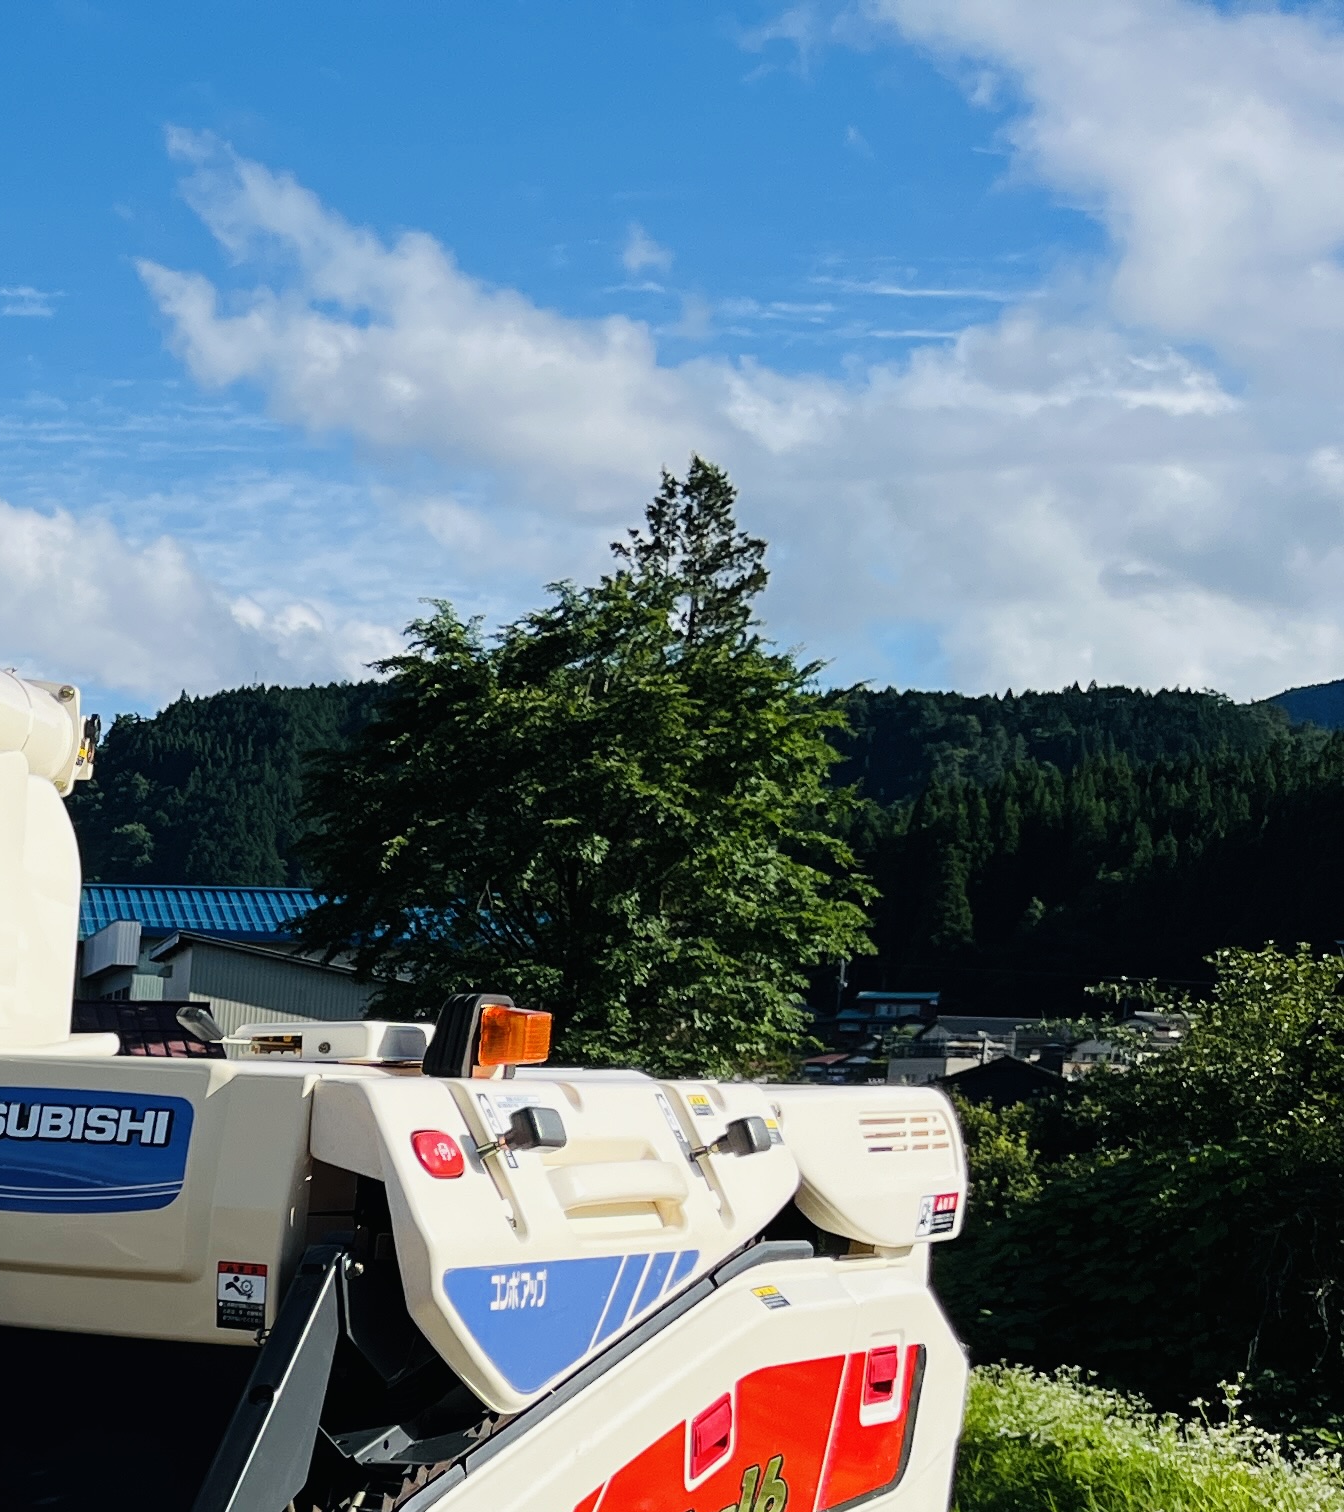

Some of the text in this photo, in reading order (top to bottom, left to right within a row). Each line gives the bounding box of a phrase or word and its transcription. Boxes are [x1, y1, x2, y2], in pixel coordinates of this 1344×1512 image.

[490, 1269, 547, 1311] コンポアップ
